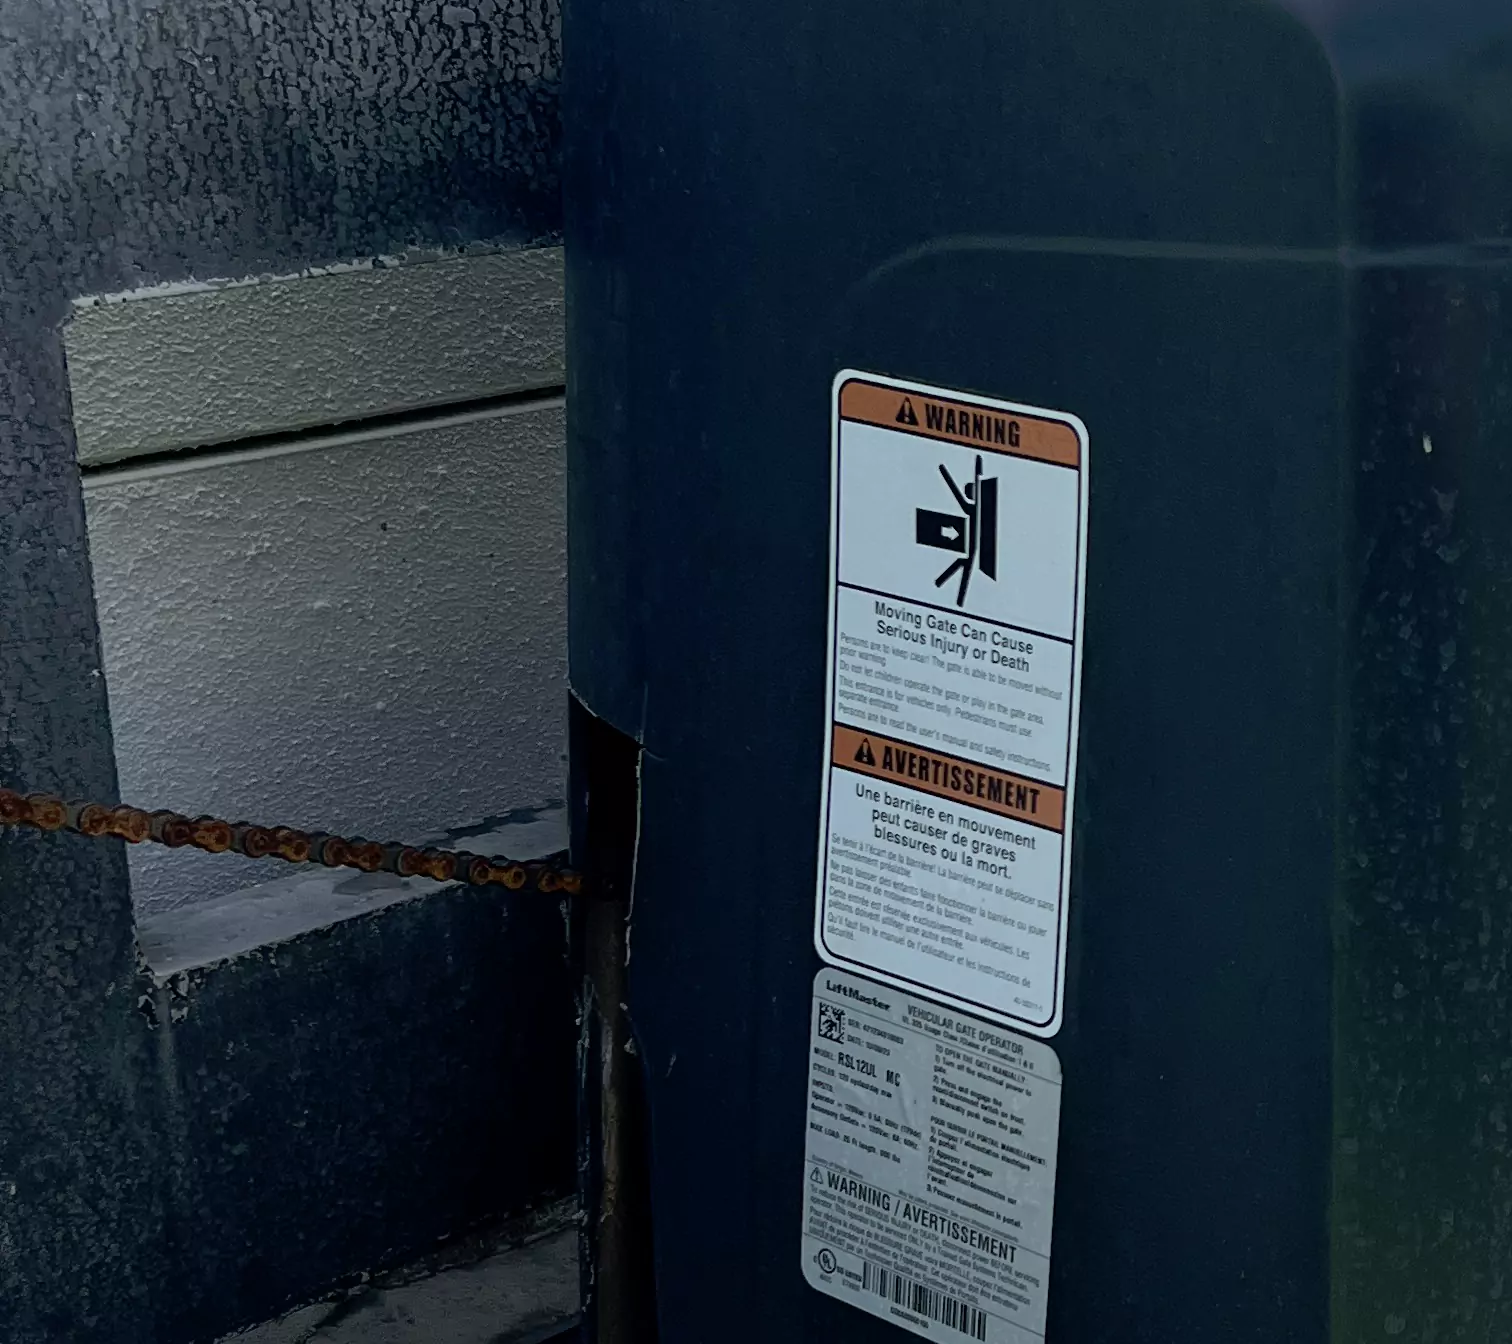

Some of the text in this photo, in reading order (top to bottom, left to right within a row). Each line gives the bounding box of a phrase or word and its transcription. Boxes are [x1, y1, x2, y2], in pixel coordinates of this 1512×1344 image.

[924, 402, 1021, 448] WARNING
[874, 599, 1034, 655] Moving Gate Can Cause
[876, 618, 1030, 673] Serious Injury or Death
[881, 743, 1040, 815] AVERTISSEMENT
[855, 781, 1036, 850] Une barrière en mouvement
[872, 806, 1016, 866] peut causer de graves
[874, 823, 1011, 880] blessures ou la mort.
[826, 978, 890, 1012] LiftMaster
[907, 1004, 953, 1030] VEHICULAR
[955, 1021, 977, 1039] GATE
[979, 1029, 1023, 1055] OPERATOR
[837, 1051, 877, 1078] RSL12UL
[826, 1170, 890, 1212] WARNING
[893, 1197, 900, 1218] /
[902, 1201, 1016, 1264] AVERTISSEMENT
